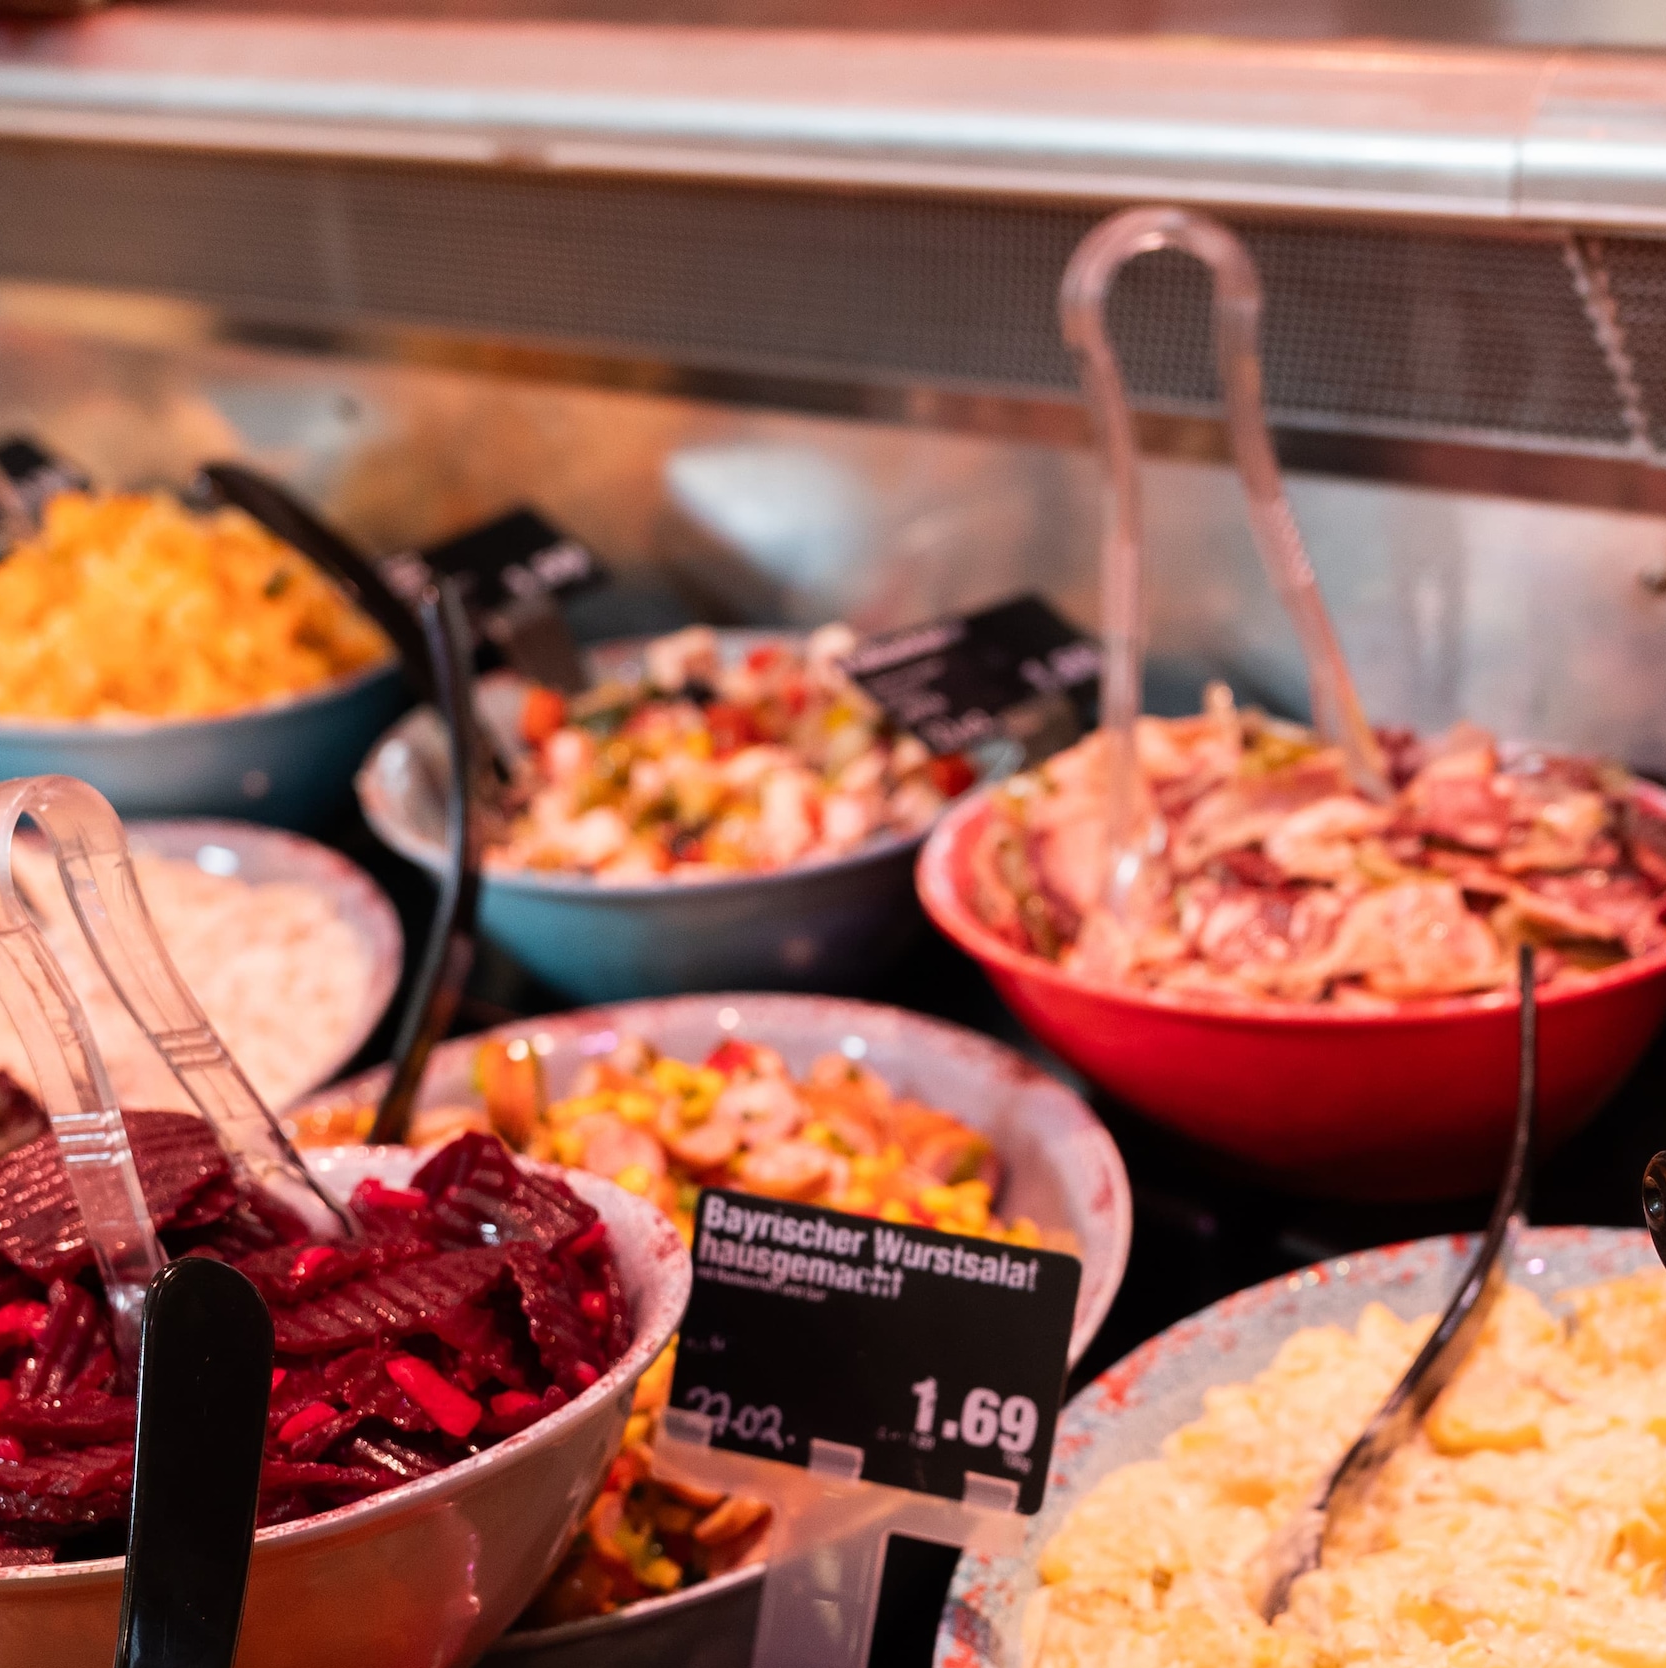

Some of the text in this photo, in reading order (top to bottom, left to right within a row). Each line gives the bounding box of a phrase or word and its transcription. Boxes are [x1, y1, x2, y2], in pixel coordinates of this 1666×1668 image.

[702, 1195, 868, 1257] Bayrischer
[873, 1226, 1040, 1292] Wurstsalat
[912, 1375, 1039, 1454] 1.69
